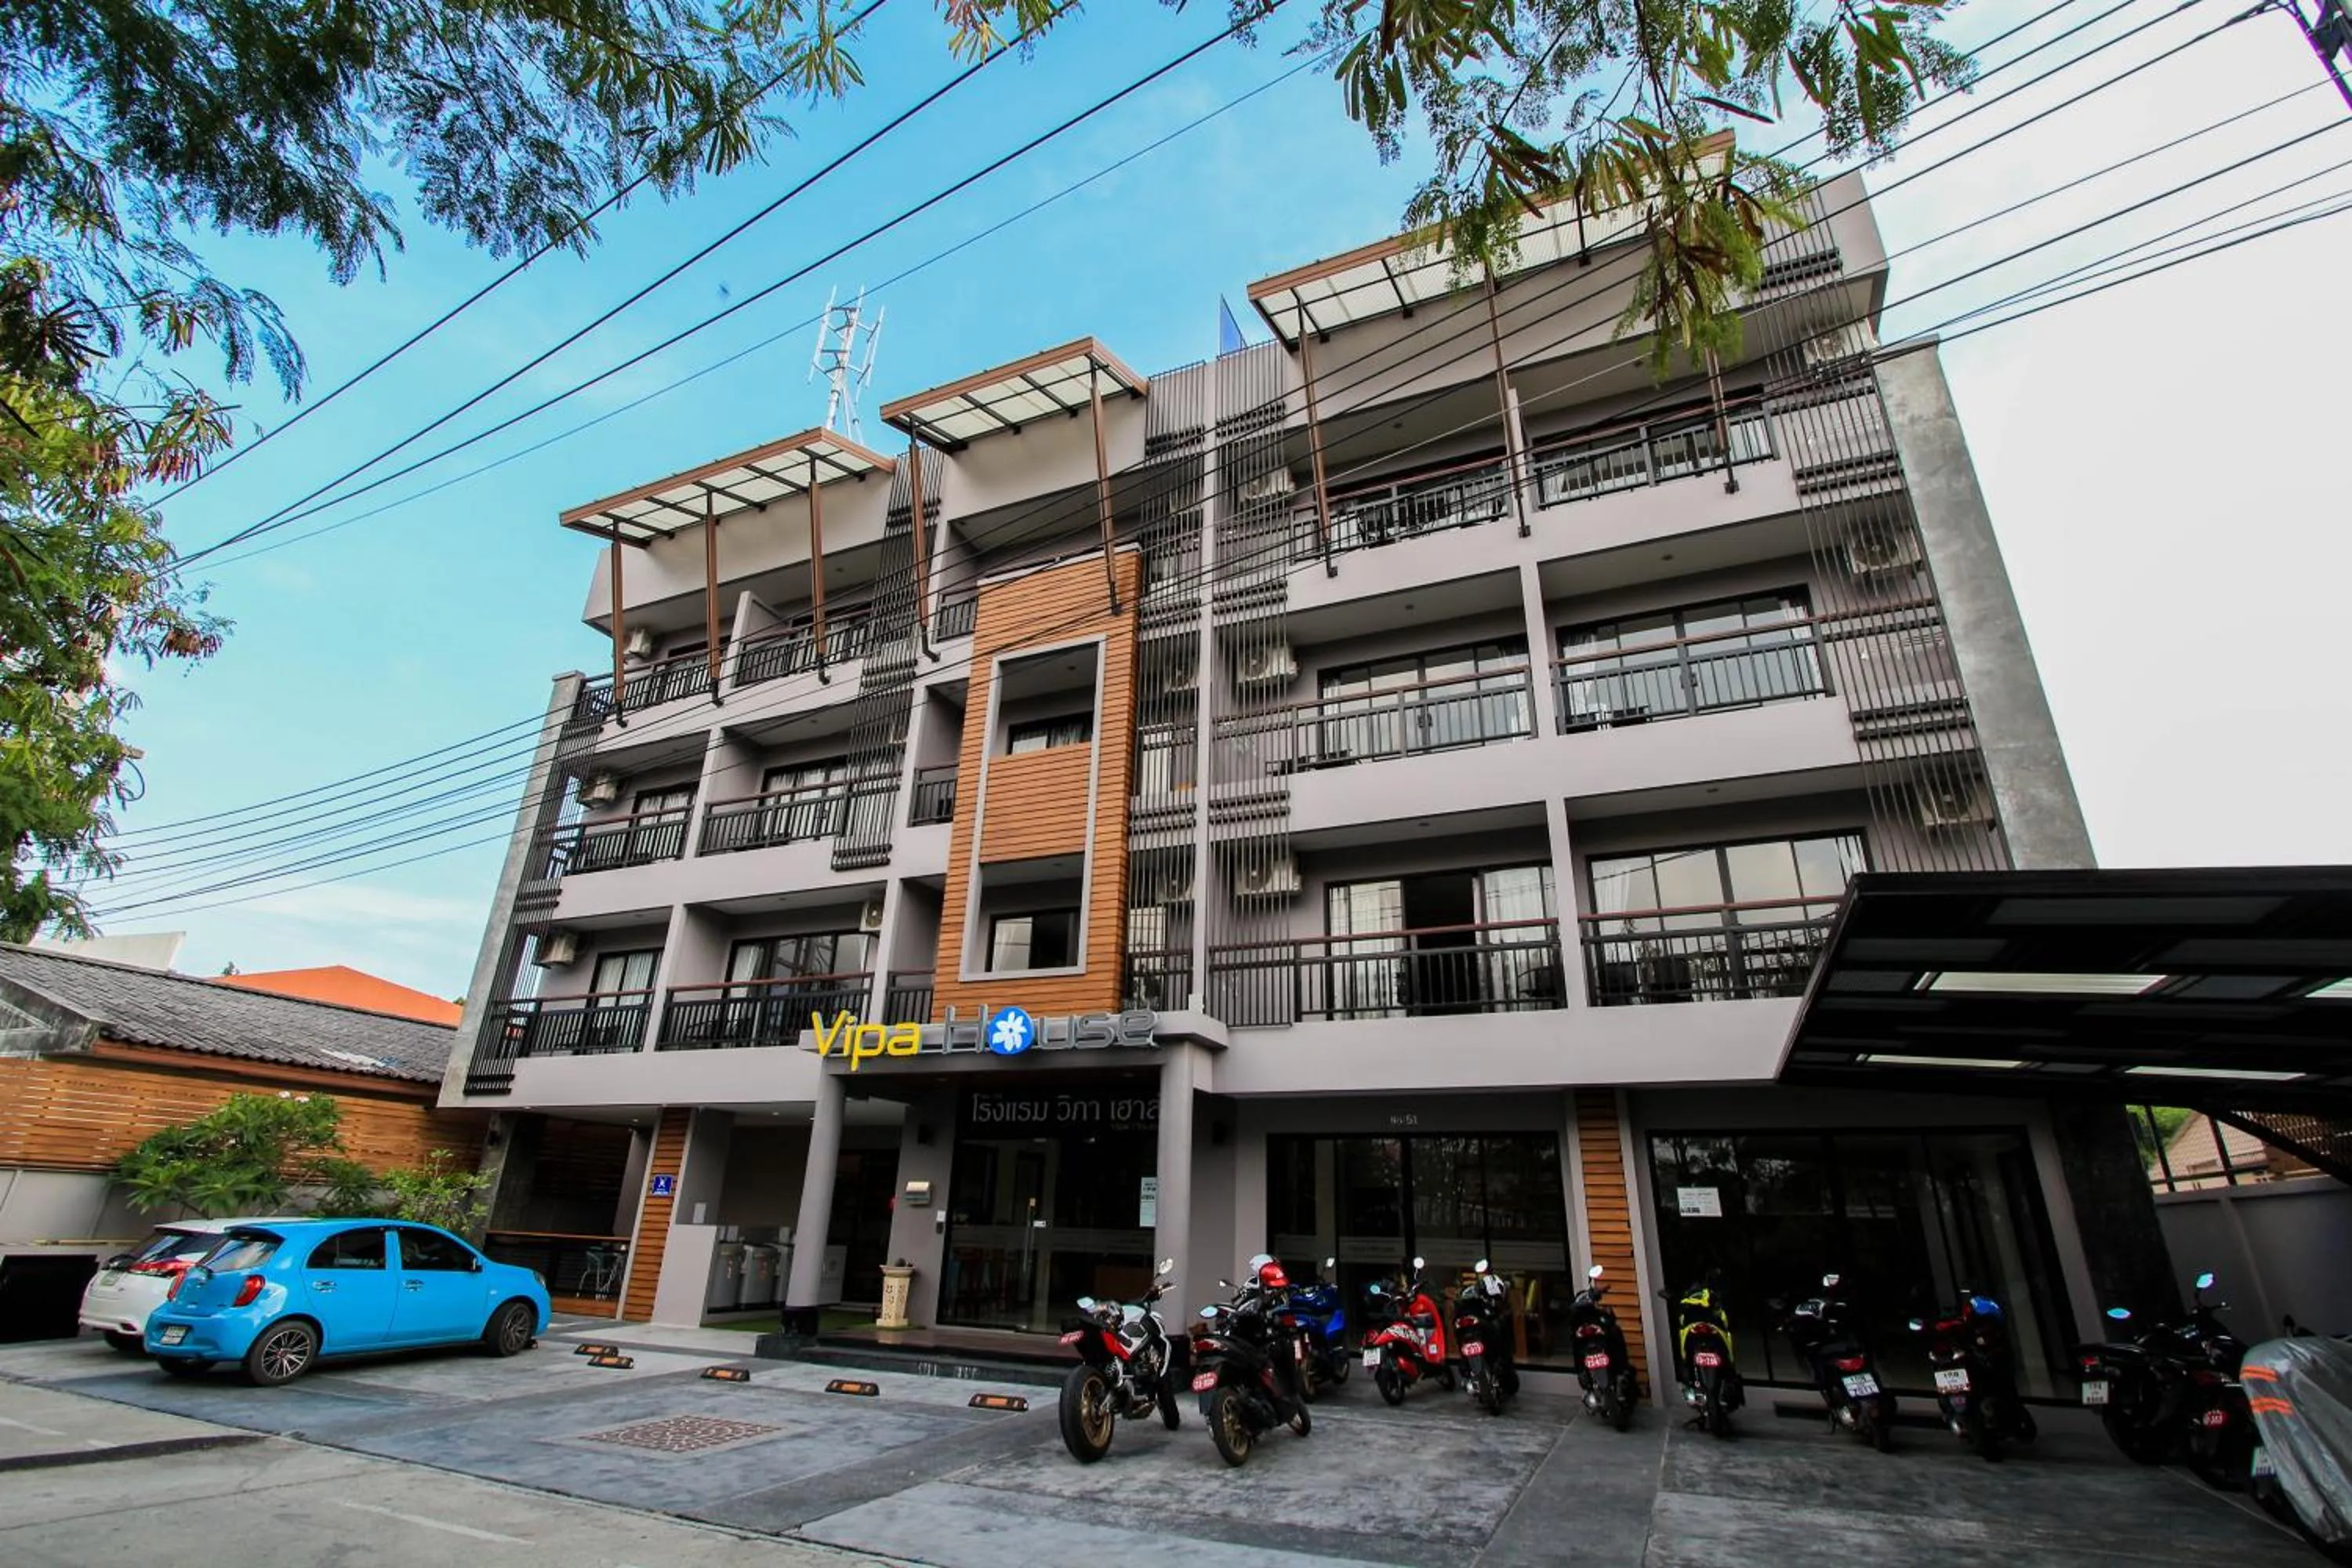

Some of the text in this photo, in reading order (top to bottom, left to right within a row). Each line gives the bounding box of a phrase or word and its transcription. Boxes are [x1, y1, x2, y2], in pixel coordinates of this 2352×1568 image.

[811, 1009, 922, 1072] Vipa
[971, 1092, 1050, 1123] โรงแรม
